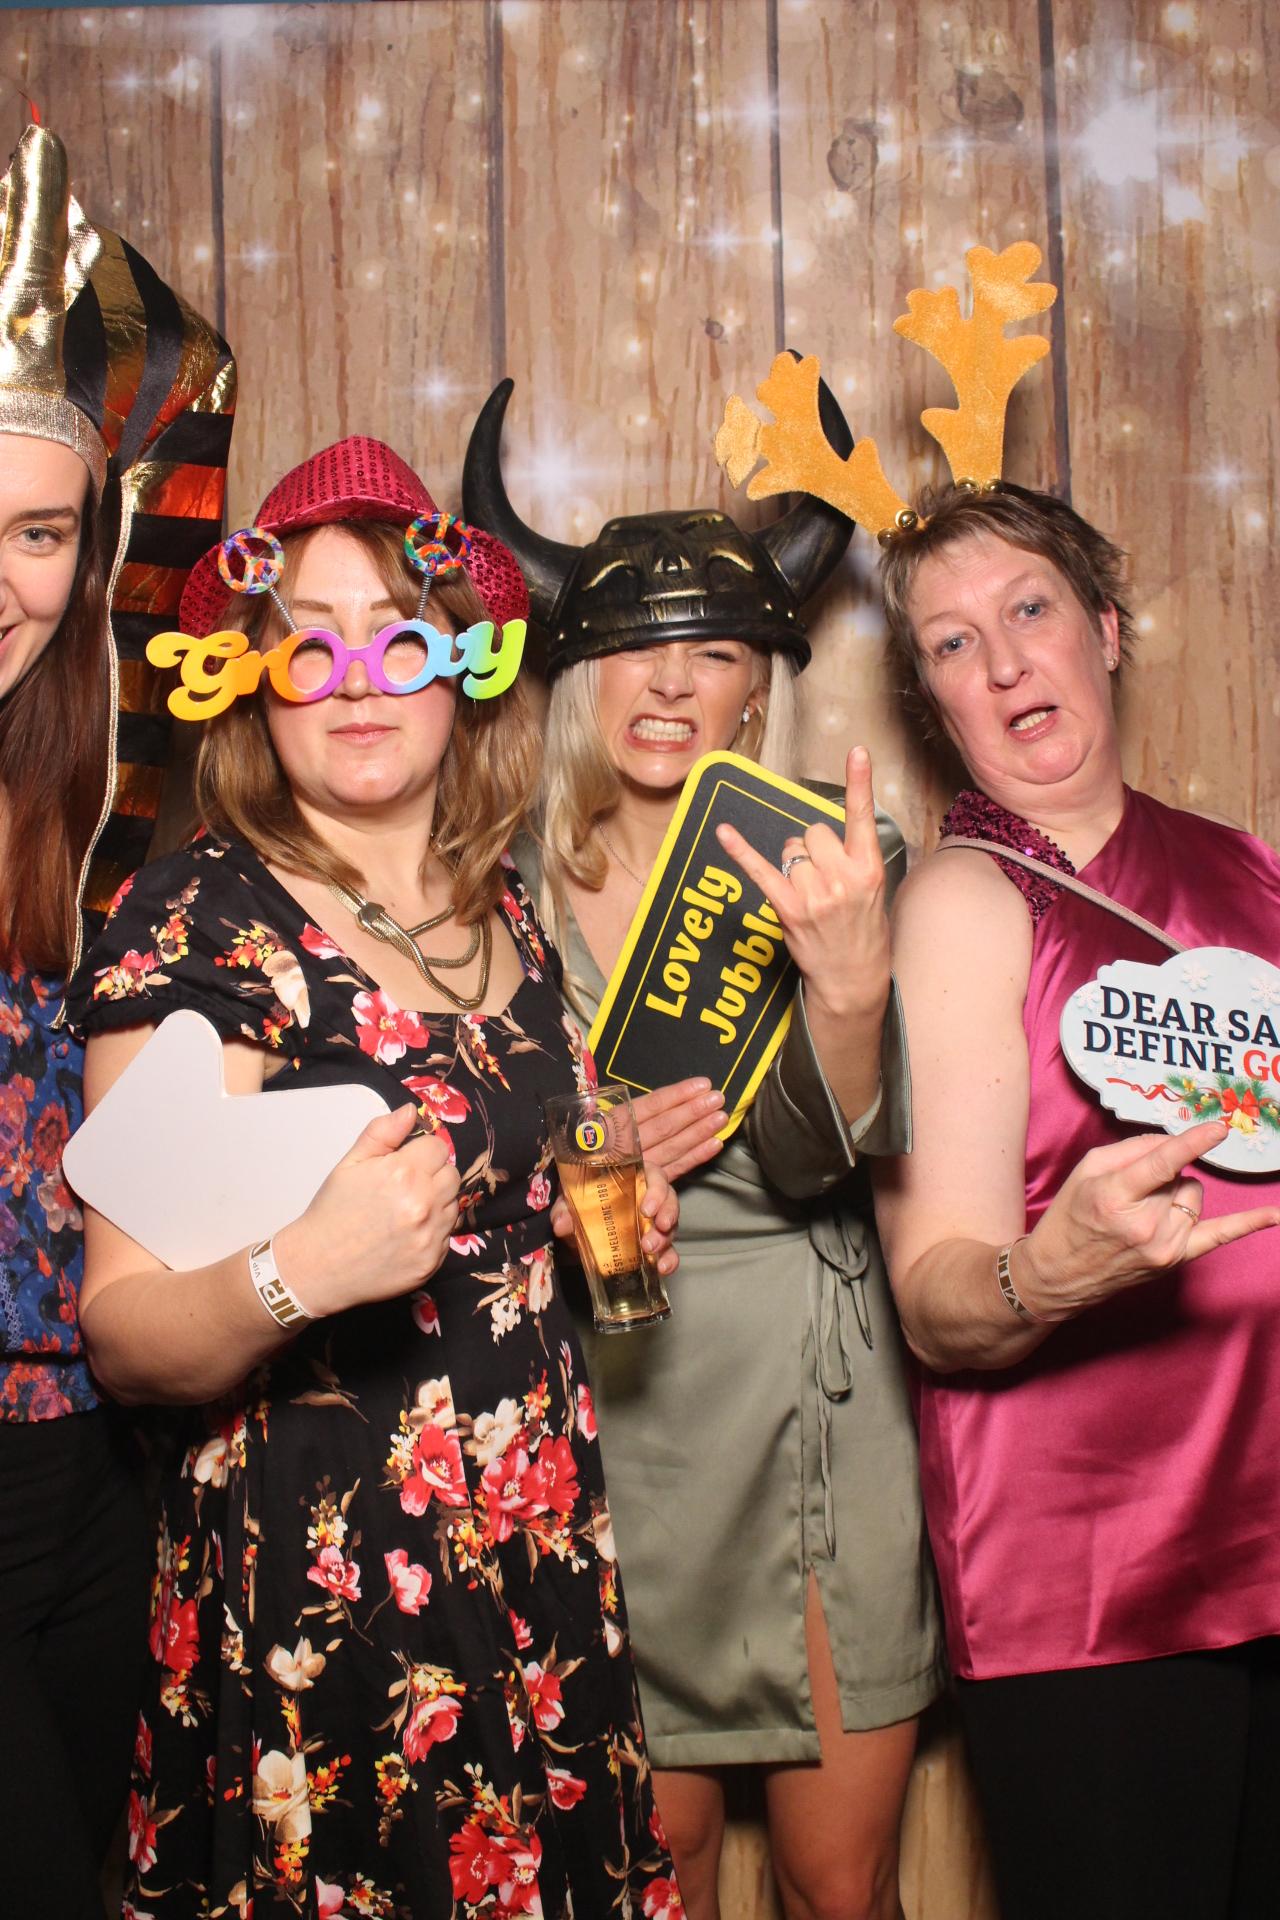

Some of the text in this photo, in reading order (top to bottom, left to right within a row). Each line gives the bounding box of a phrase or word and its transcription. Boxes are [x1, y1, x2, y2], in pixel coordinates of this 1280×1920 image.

[645, 865, 743, 1018] Lovely
[1100, 985, 1219, 1037] DEAR
[1083, 1020, 1235, 1075] DEFINE
[601, 1204, 620, 1253] MELBOURNE
[252, 1262, 262, 1279] VIP
